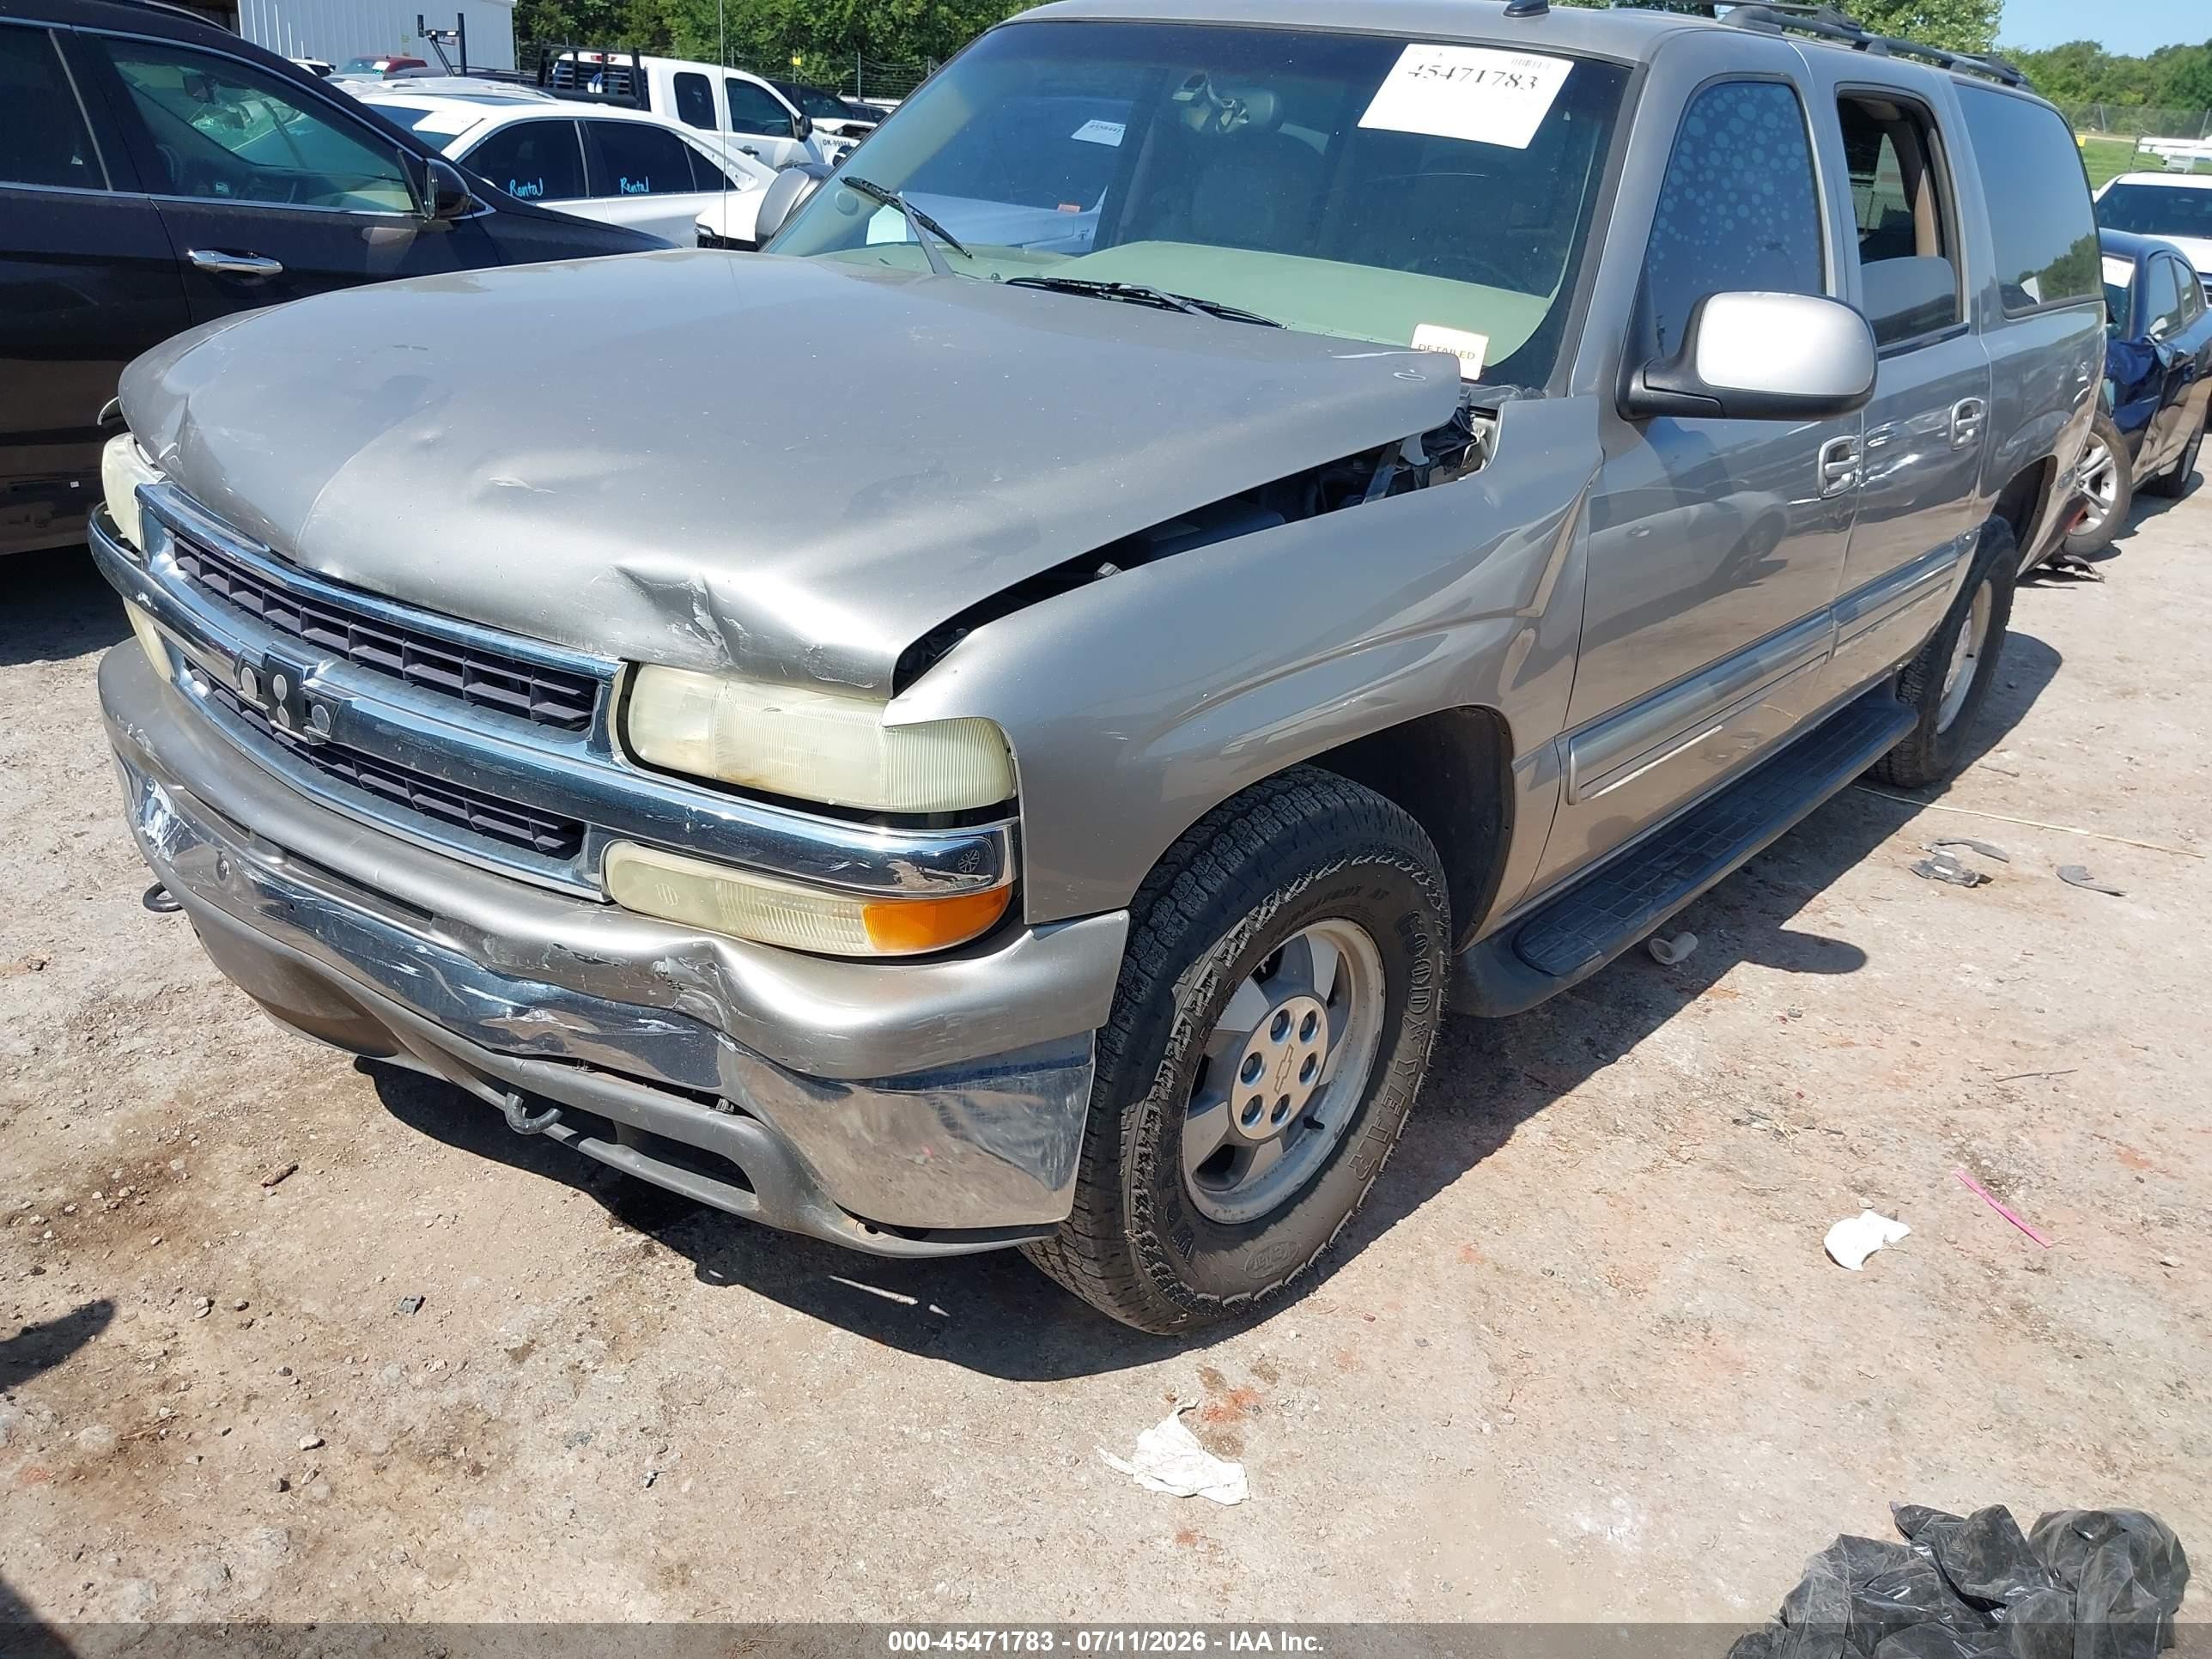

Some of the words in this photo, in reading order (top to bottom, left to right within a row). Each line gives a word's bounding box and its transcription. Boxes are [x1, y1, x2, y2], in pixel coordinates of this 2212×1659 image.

[1407, 63, 1540, 91] 45471783
[509, 177, 544, 198] Rental
[619, 176, 650, 195] Rental
[1418, 343, 1476, 360] DETAILED
[1347, 910, 1431, 1181] GOODYEAR
